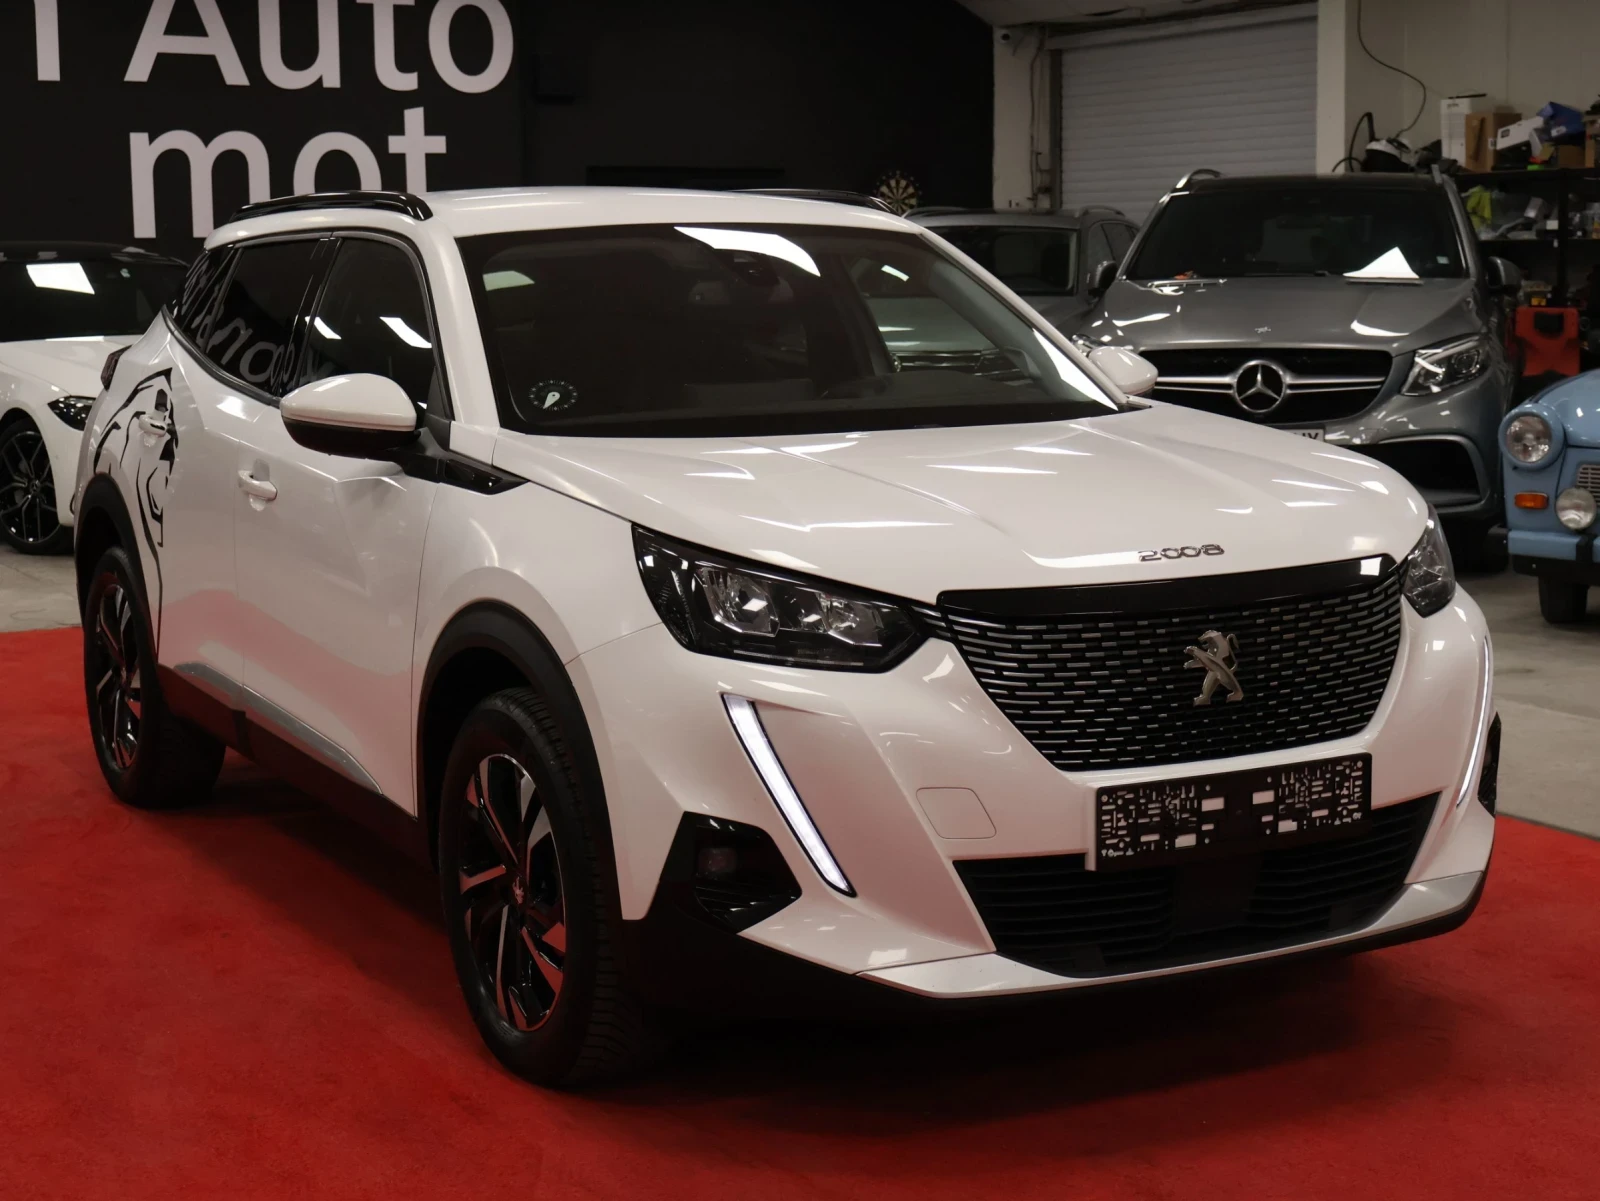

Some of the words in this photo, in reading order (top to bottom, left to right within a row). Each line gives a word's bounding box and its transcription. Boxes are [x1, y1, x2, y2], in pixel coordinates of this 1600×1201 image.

[123, 0, 514, 94] Auto
[129, 106, 448, 239] mot
[1138, 543, 1225, 562] 2008
